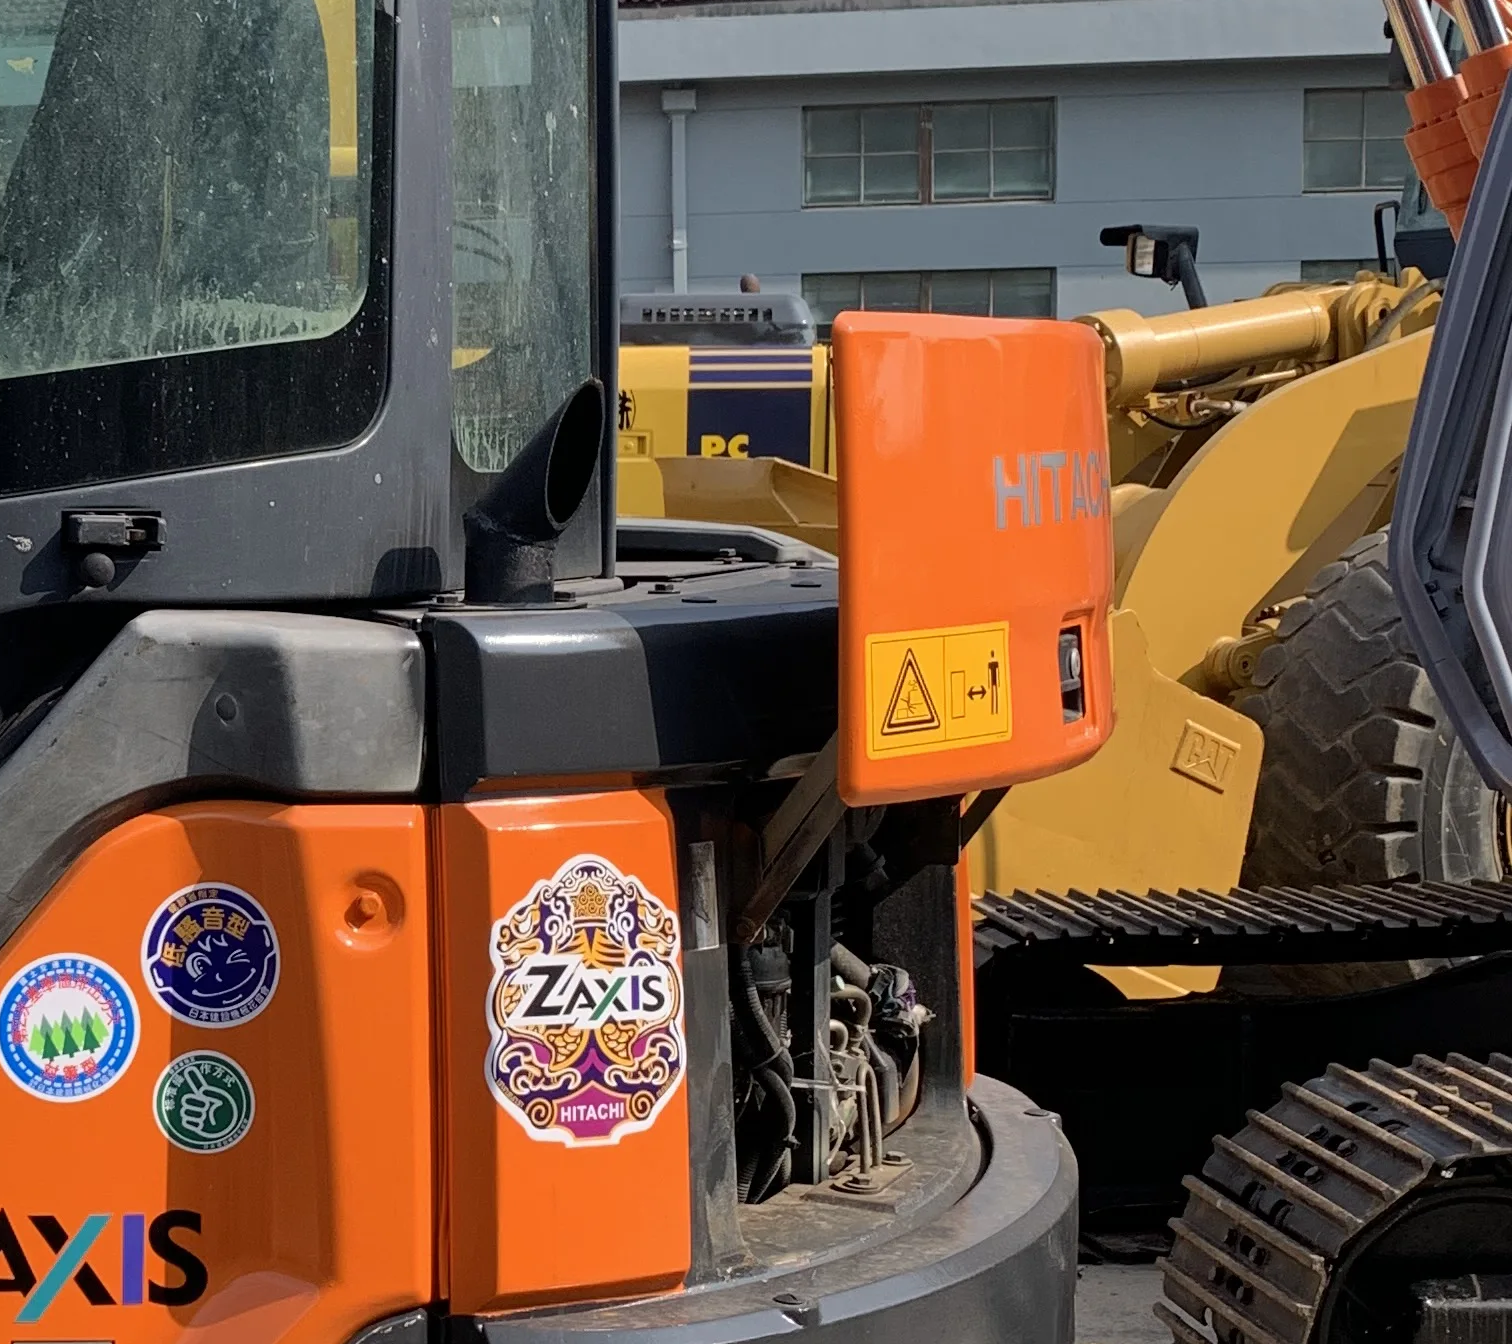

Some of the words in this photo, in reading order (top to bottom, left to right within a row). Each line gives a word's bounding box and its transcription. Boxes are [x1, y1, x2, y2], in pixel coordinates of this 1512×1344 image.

[701, 434, 749, 459] PC
[521, 963, 666, 1021] ZAXIS
[560, 1102, 625, 1123] HITACHI
